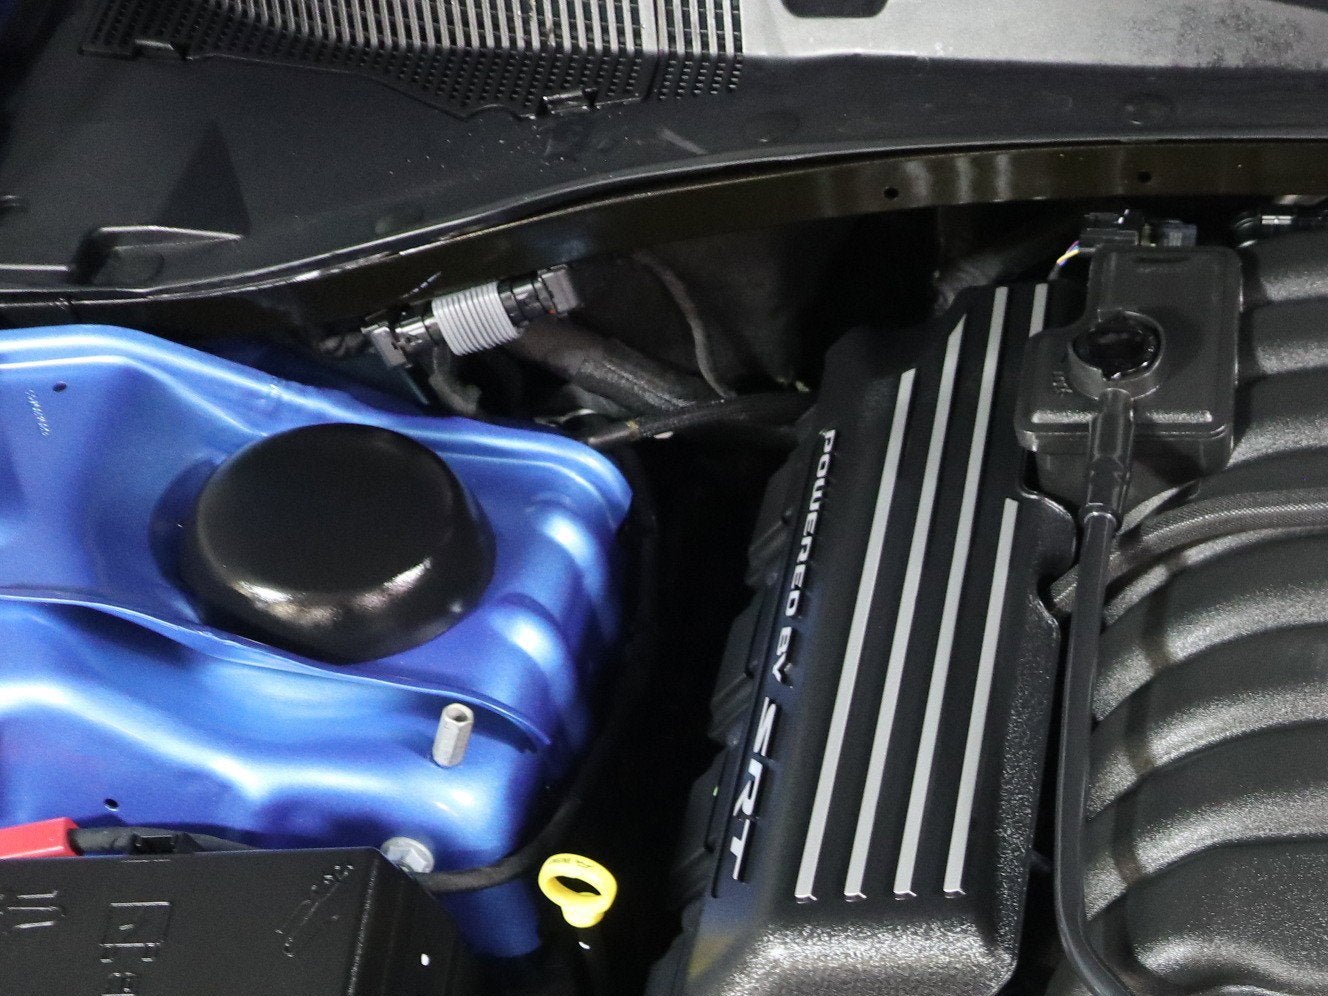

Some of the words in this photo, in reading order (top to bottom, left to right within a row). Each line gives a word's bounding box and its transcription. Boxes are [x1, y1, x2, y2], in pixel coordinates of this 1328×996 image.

[785, 428, 837, 618] POWERED
[771, 626, 795, 684] BY
[731, 697, 782, 881] SRT
